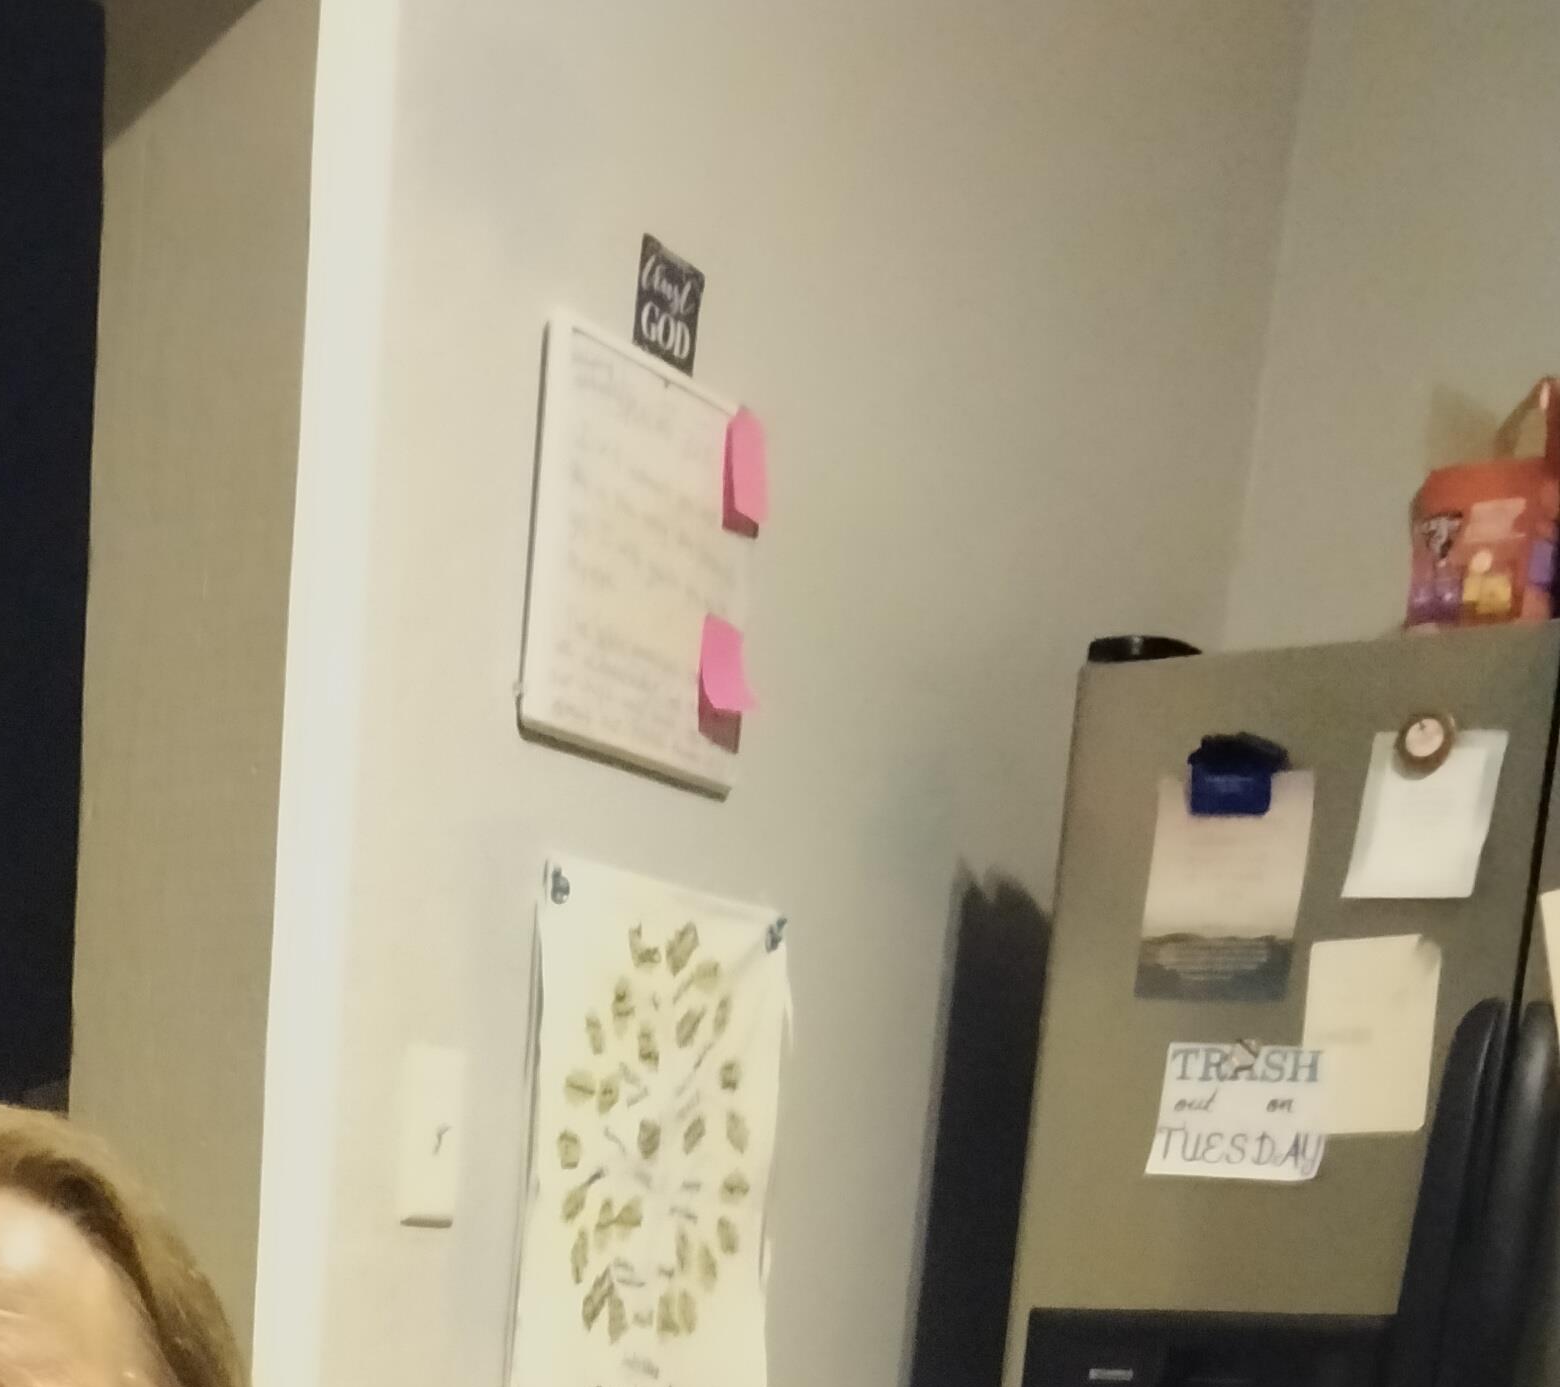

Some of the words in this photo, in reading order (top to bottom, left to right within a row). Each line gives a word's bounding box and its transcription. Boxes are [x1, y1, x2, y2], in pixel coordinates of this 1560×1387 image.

[641, 300, 690, 360] GOD
[1265, 1098, 1295, 1113] on
[1158, 1124, 1325, 1177] TUESDAY
